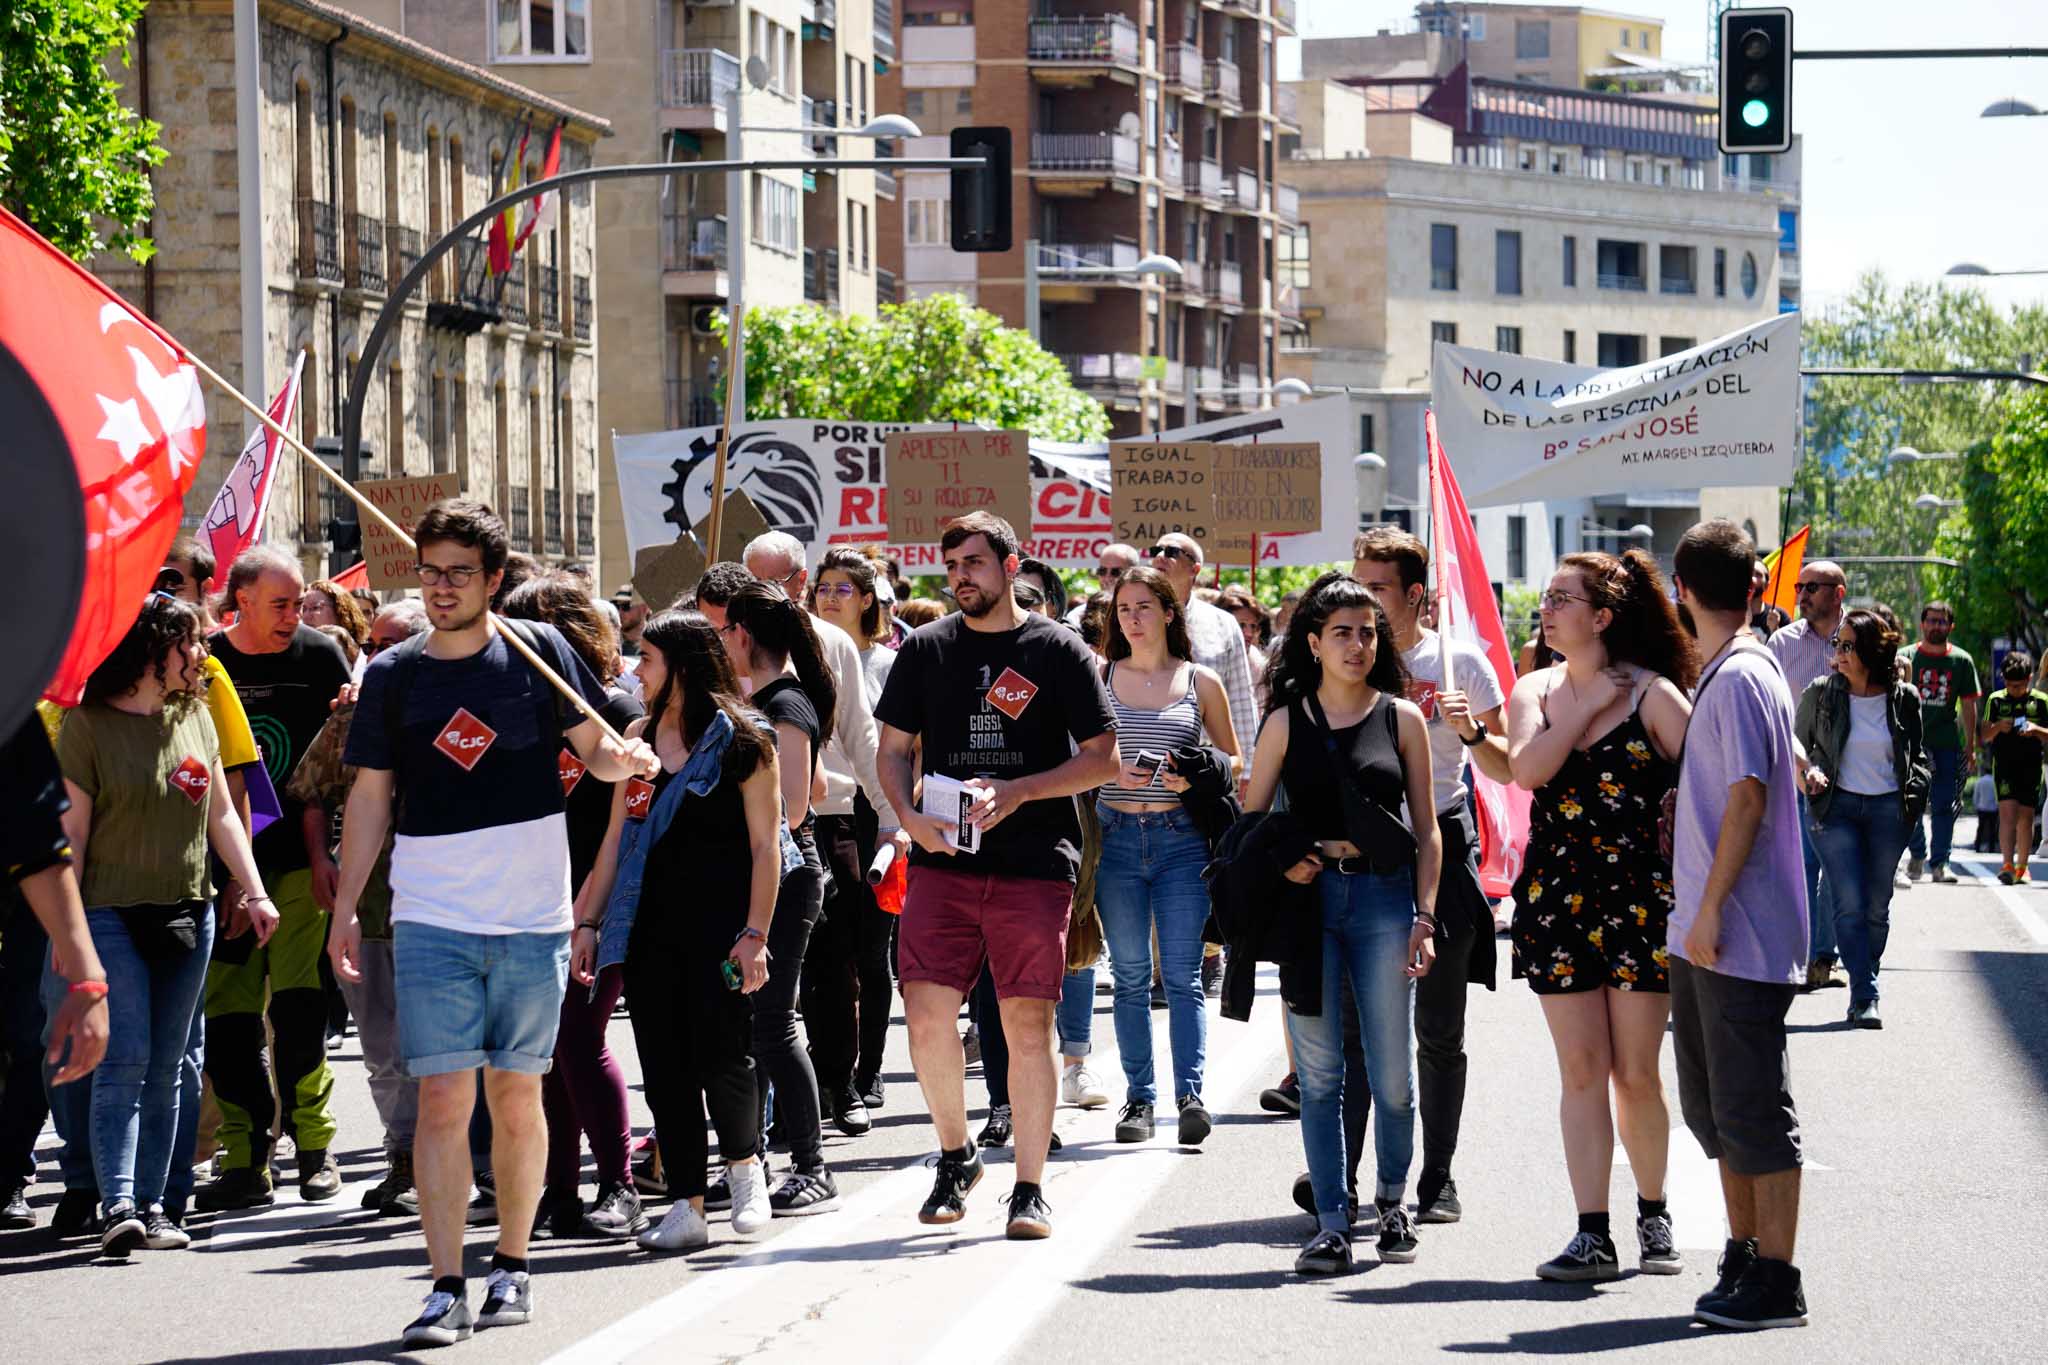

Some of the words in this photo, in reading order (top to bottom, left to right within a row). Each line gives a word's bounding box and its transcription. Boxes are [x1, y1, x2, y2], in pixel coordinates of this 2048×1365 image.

[1463, 366, 1502, 392] NO
[1509, 378, 1526, 397] A
[1535, 379, 1566, 398] LA
[1483, 408, 1517, 426] DE
[1526, 413, 1574, 429] LAS
[1706, 374, 1751, 395] DEL
[813, 425, 869, 443] POR
[1576, 429, 1627, 454] SAN
[1633, 405, 1699, 440] JOSÉ
[897, 437, 973, 461] APUESTA
[983, 434, 1014, 458] POR
[1124, 447, 1197, 463] IGUAL
[1621, 453, 1641, 465] MI
[1643, 446, 1698, 462] MARGEN
[1702, 441, 1775, 458] IZQUIERDA
[938, 461, 961, 484] TI
[1115, 469, 1205, 487] TRABAJO
[369, 483, 446, 504] NATIVA
[903, 488, 922, 506] SU
[1131, 497, 1199, 513] IGUAL
[1006, 690, 1029, 702] CJC
[459, 736, 486, 749] CJC
[969, 732, 1005, 749] SORDA
[961, 751, 1025, 766] POLSEGUERA
[190, 777, 209, 786] CJC
